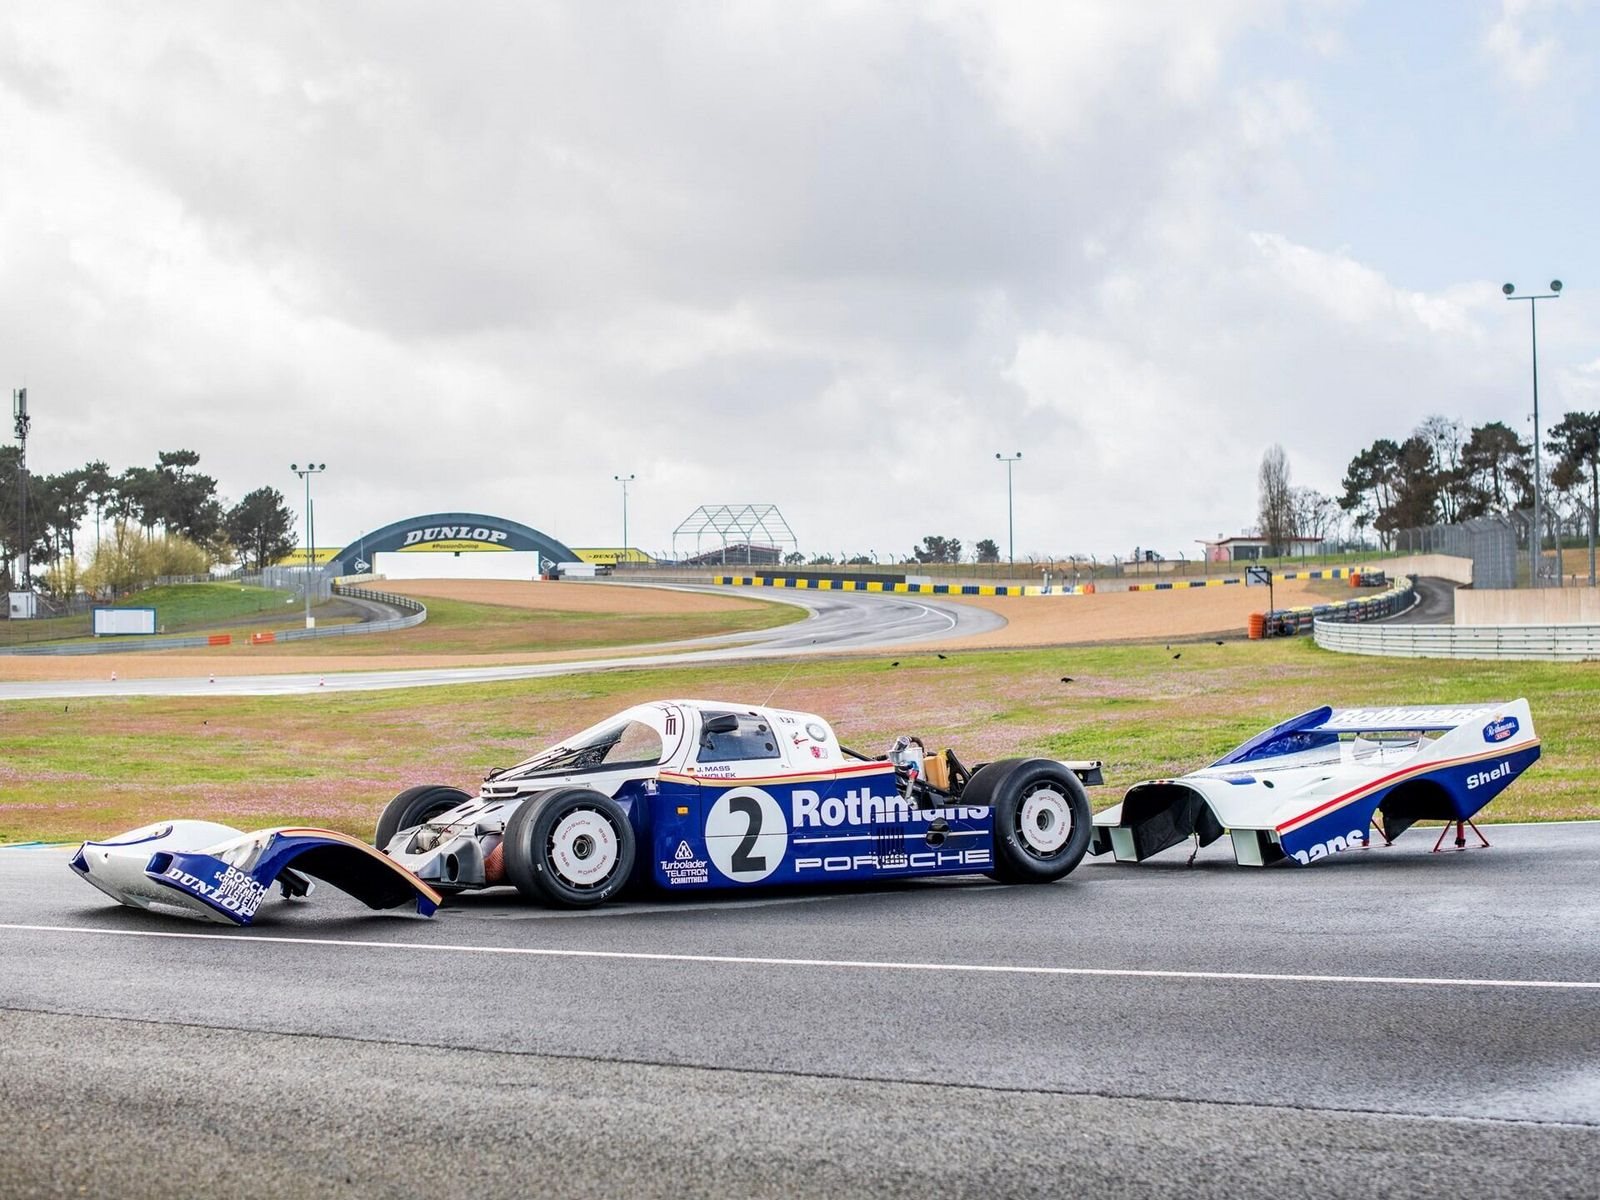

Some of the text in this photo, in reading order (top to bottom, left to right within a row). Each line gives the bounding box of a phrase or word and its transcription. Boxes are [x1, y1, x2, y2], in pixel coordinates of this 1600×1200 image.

[404, 526, 508, 546] DUNLOP
[1466, 761, 1511, 789] Shell
[729, 796, 767, 873] 2
[660, 860, 708, 870] Turbolader
[665, 868, 708, 878] TELETRON
[795, 849, 990, 873] PORSCHE
[166, 867, 255, 917] DUNLOP
[225, 866, 268, 898] BOSCH
[219, 883, 260, 912] BILSTEIN
